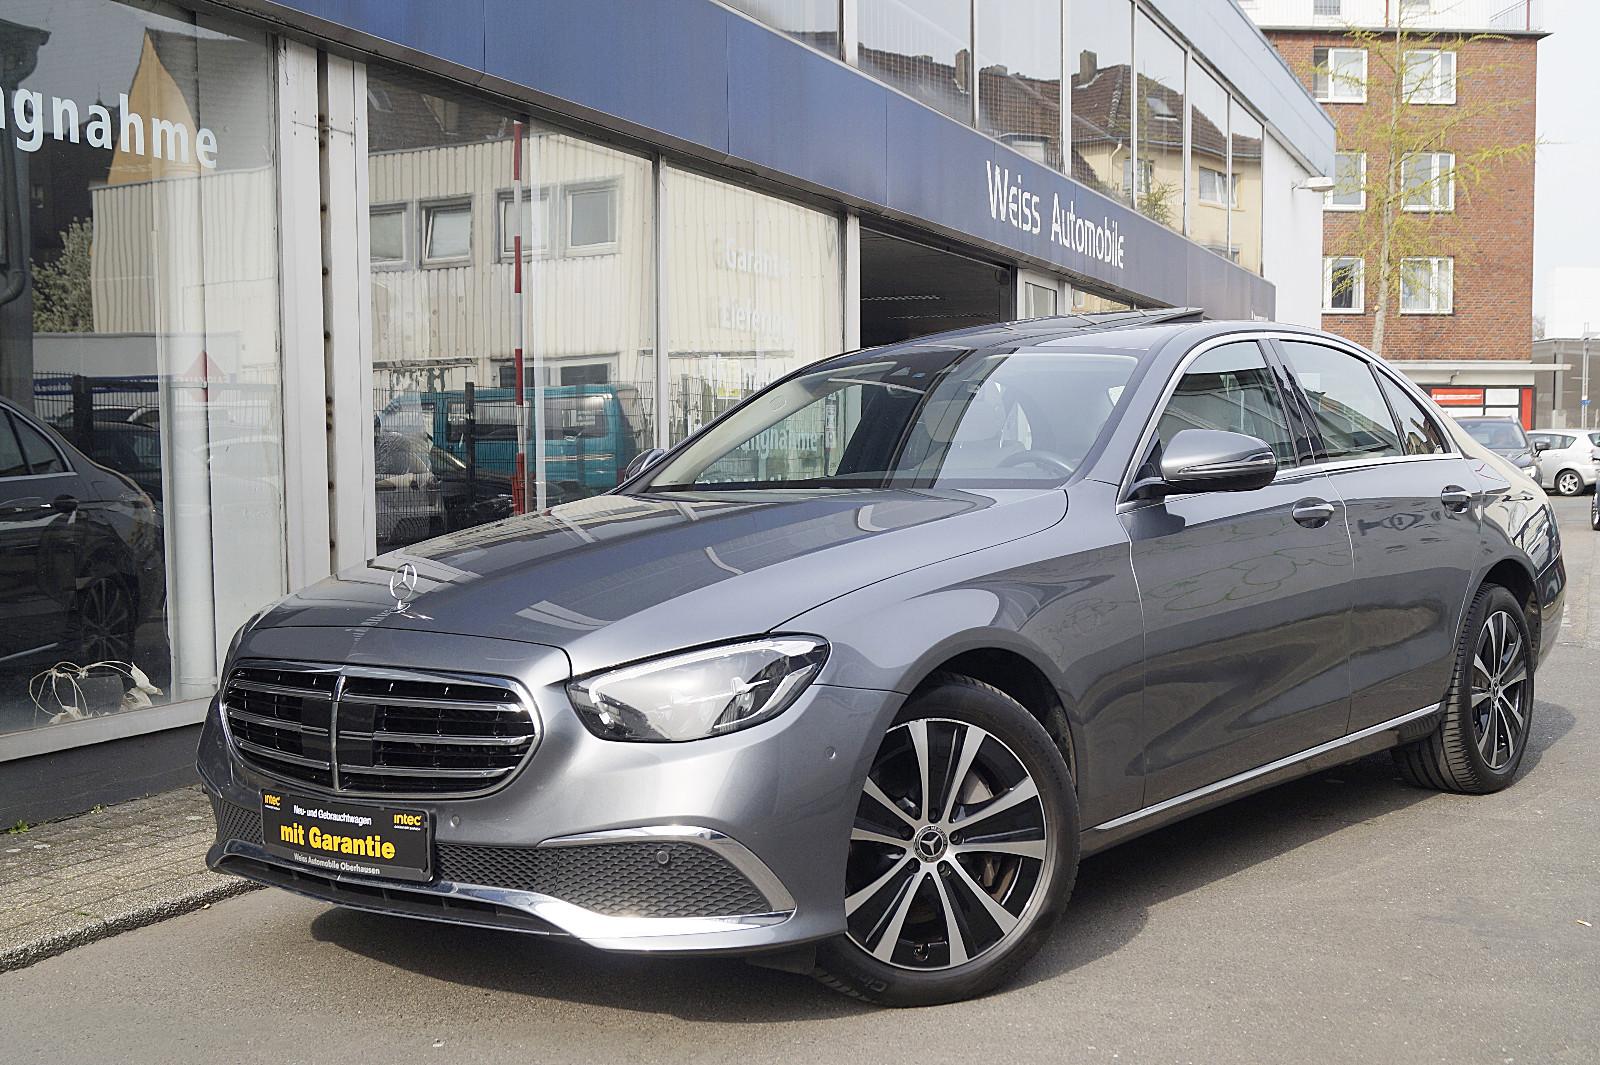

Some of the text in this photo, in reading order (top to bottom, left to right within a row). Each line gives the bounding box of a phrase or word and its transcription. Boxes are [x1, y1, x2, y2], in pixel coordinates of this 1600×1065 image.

[986, 160, 1126, 270] Weiss Automobile
[293, 804, 306, 816] Neu-
[307, 808, 318, 818] und
[318, 809, 372, 827] Gebrauchtwagen
[393, 813, 422, 826] intec
[280, 823, 396, 860] mit Garantie
[294, 852, 380, 875] Weiss Automobile Oberhausen
